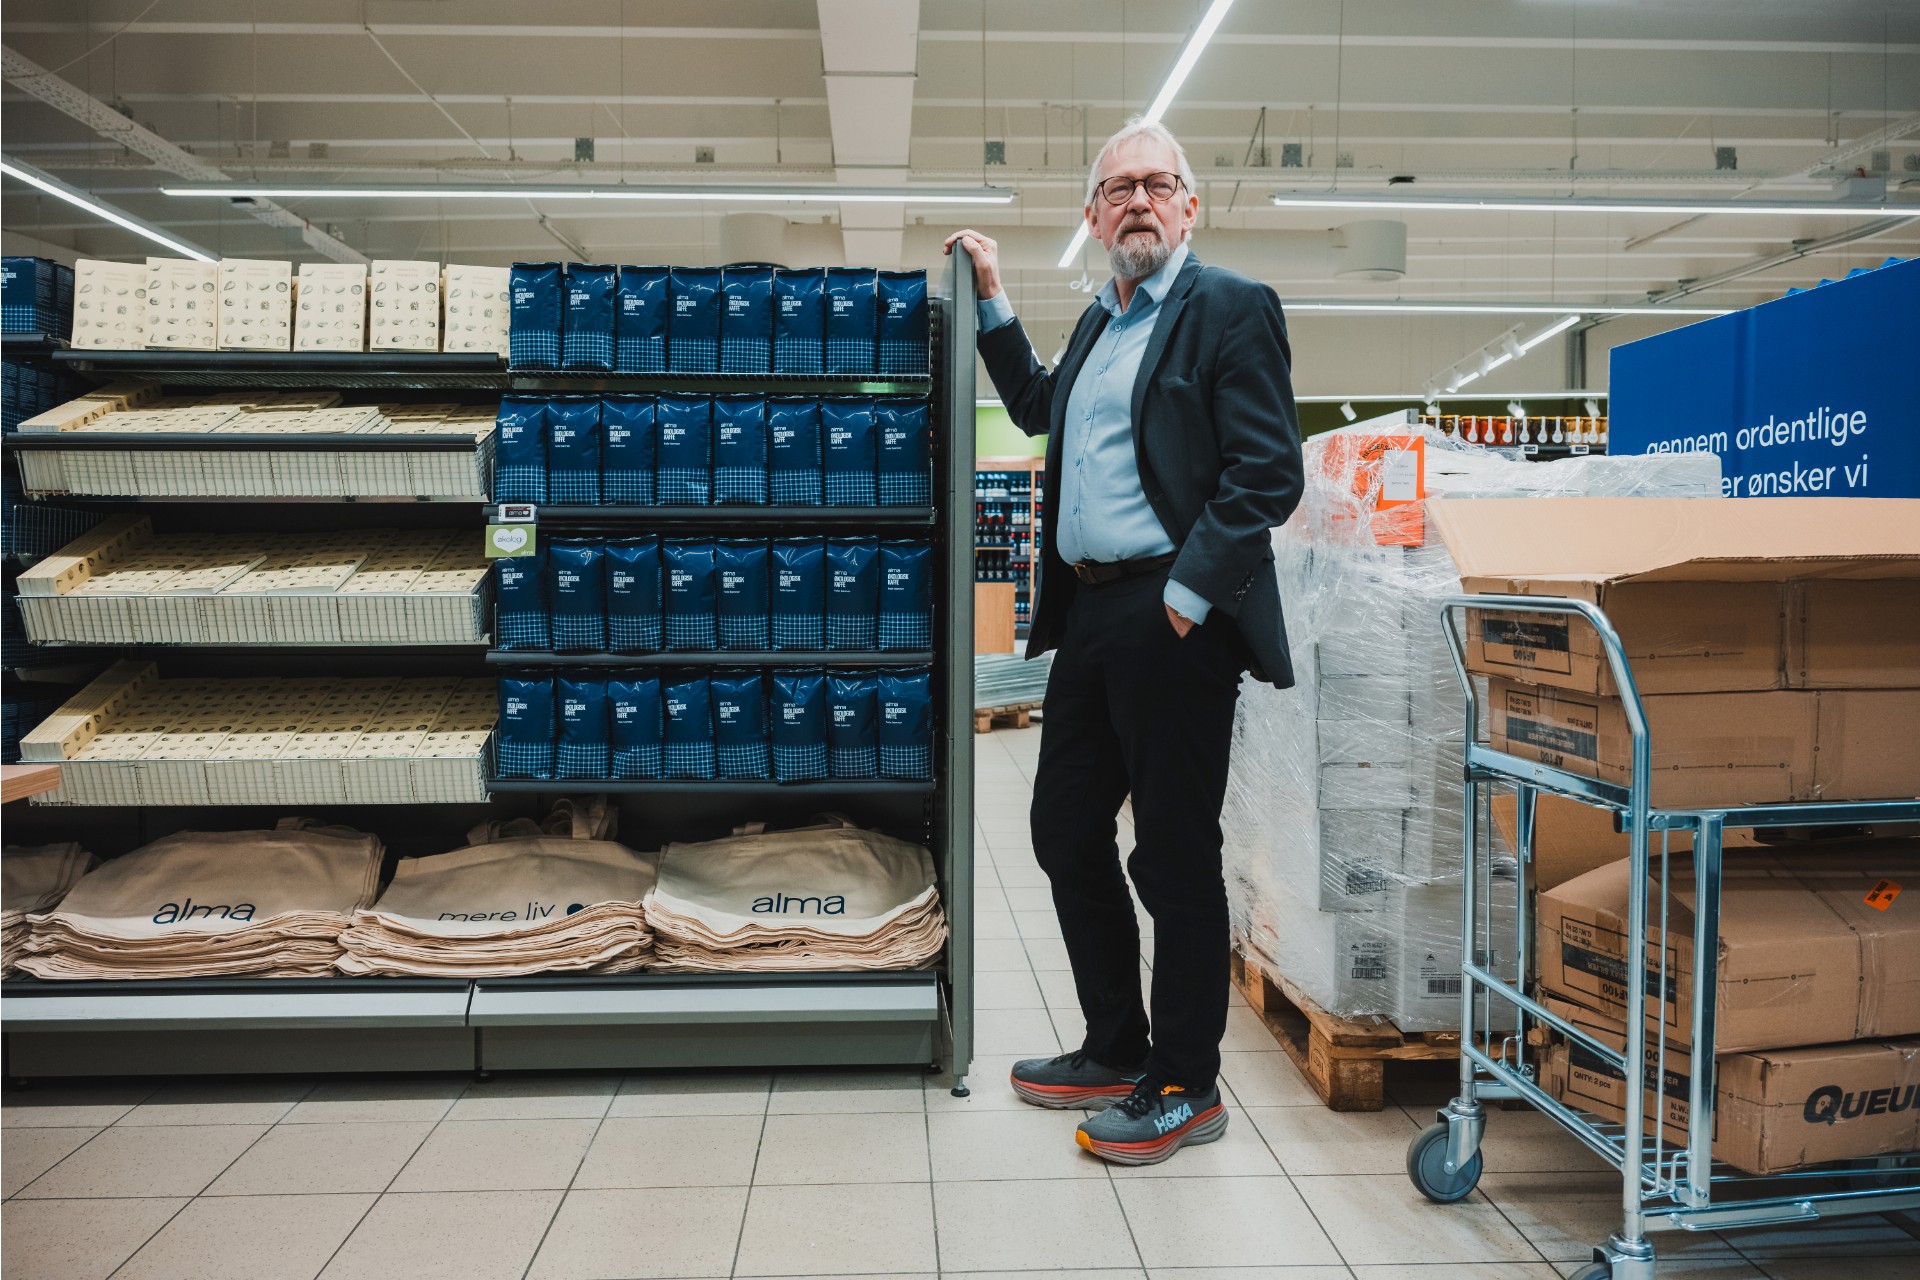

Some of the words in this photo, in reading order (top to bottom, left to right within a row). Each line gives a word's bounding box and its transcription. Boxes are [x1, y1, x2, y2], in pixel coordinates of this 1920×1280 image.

[1736, 407, 1867, 450] ordentlige
[1748, 460, 1836, 496] ønsker
[1844, 454, 1868, 488] vi
[153, 898, 256, 924] alma
[438, 911, 517, 922] mere
[526, 901, 555, 920] liv
[752, 893, 845, 914] alma
[1574, 1071, 1592, 1082] QNTY:
[1594, 1077, 1599, 1085] 2
[1599, 1079, 1611, 1089] pcs
[1153, 1103, 1194, 1134] HOKA
[1804, 1085, 1920, 1126] QUEU
